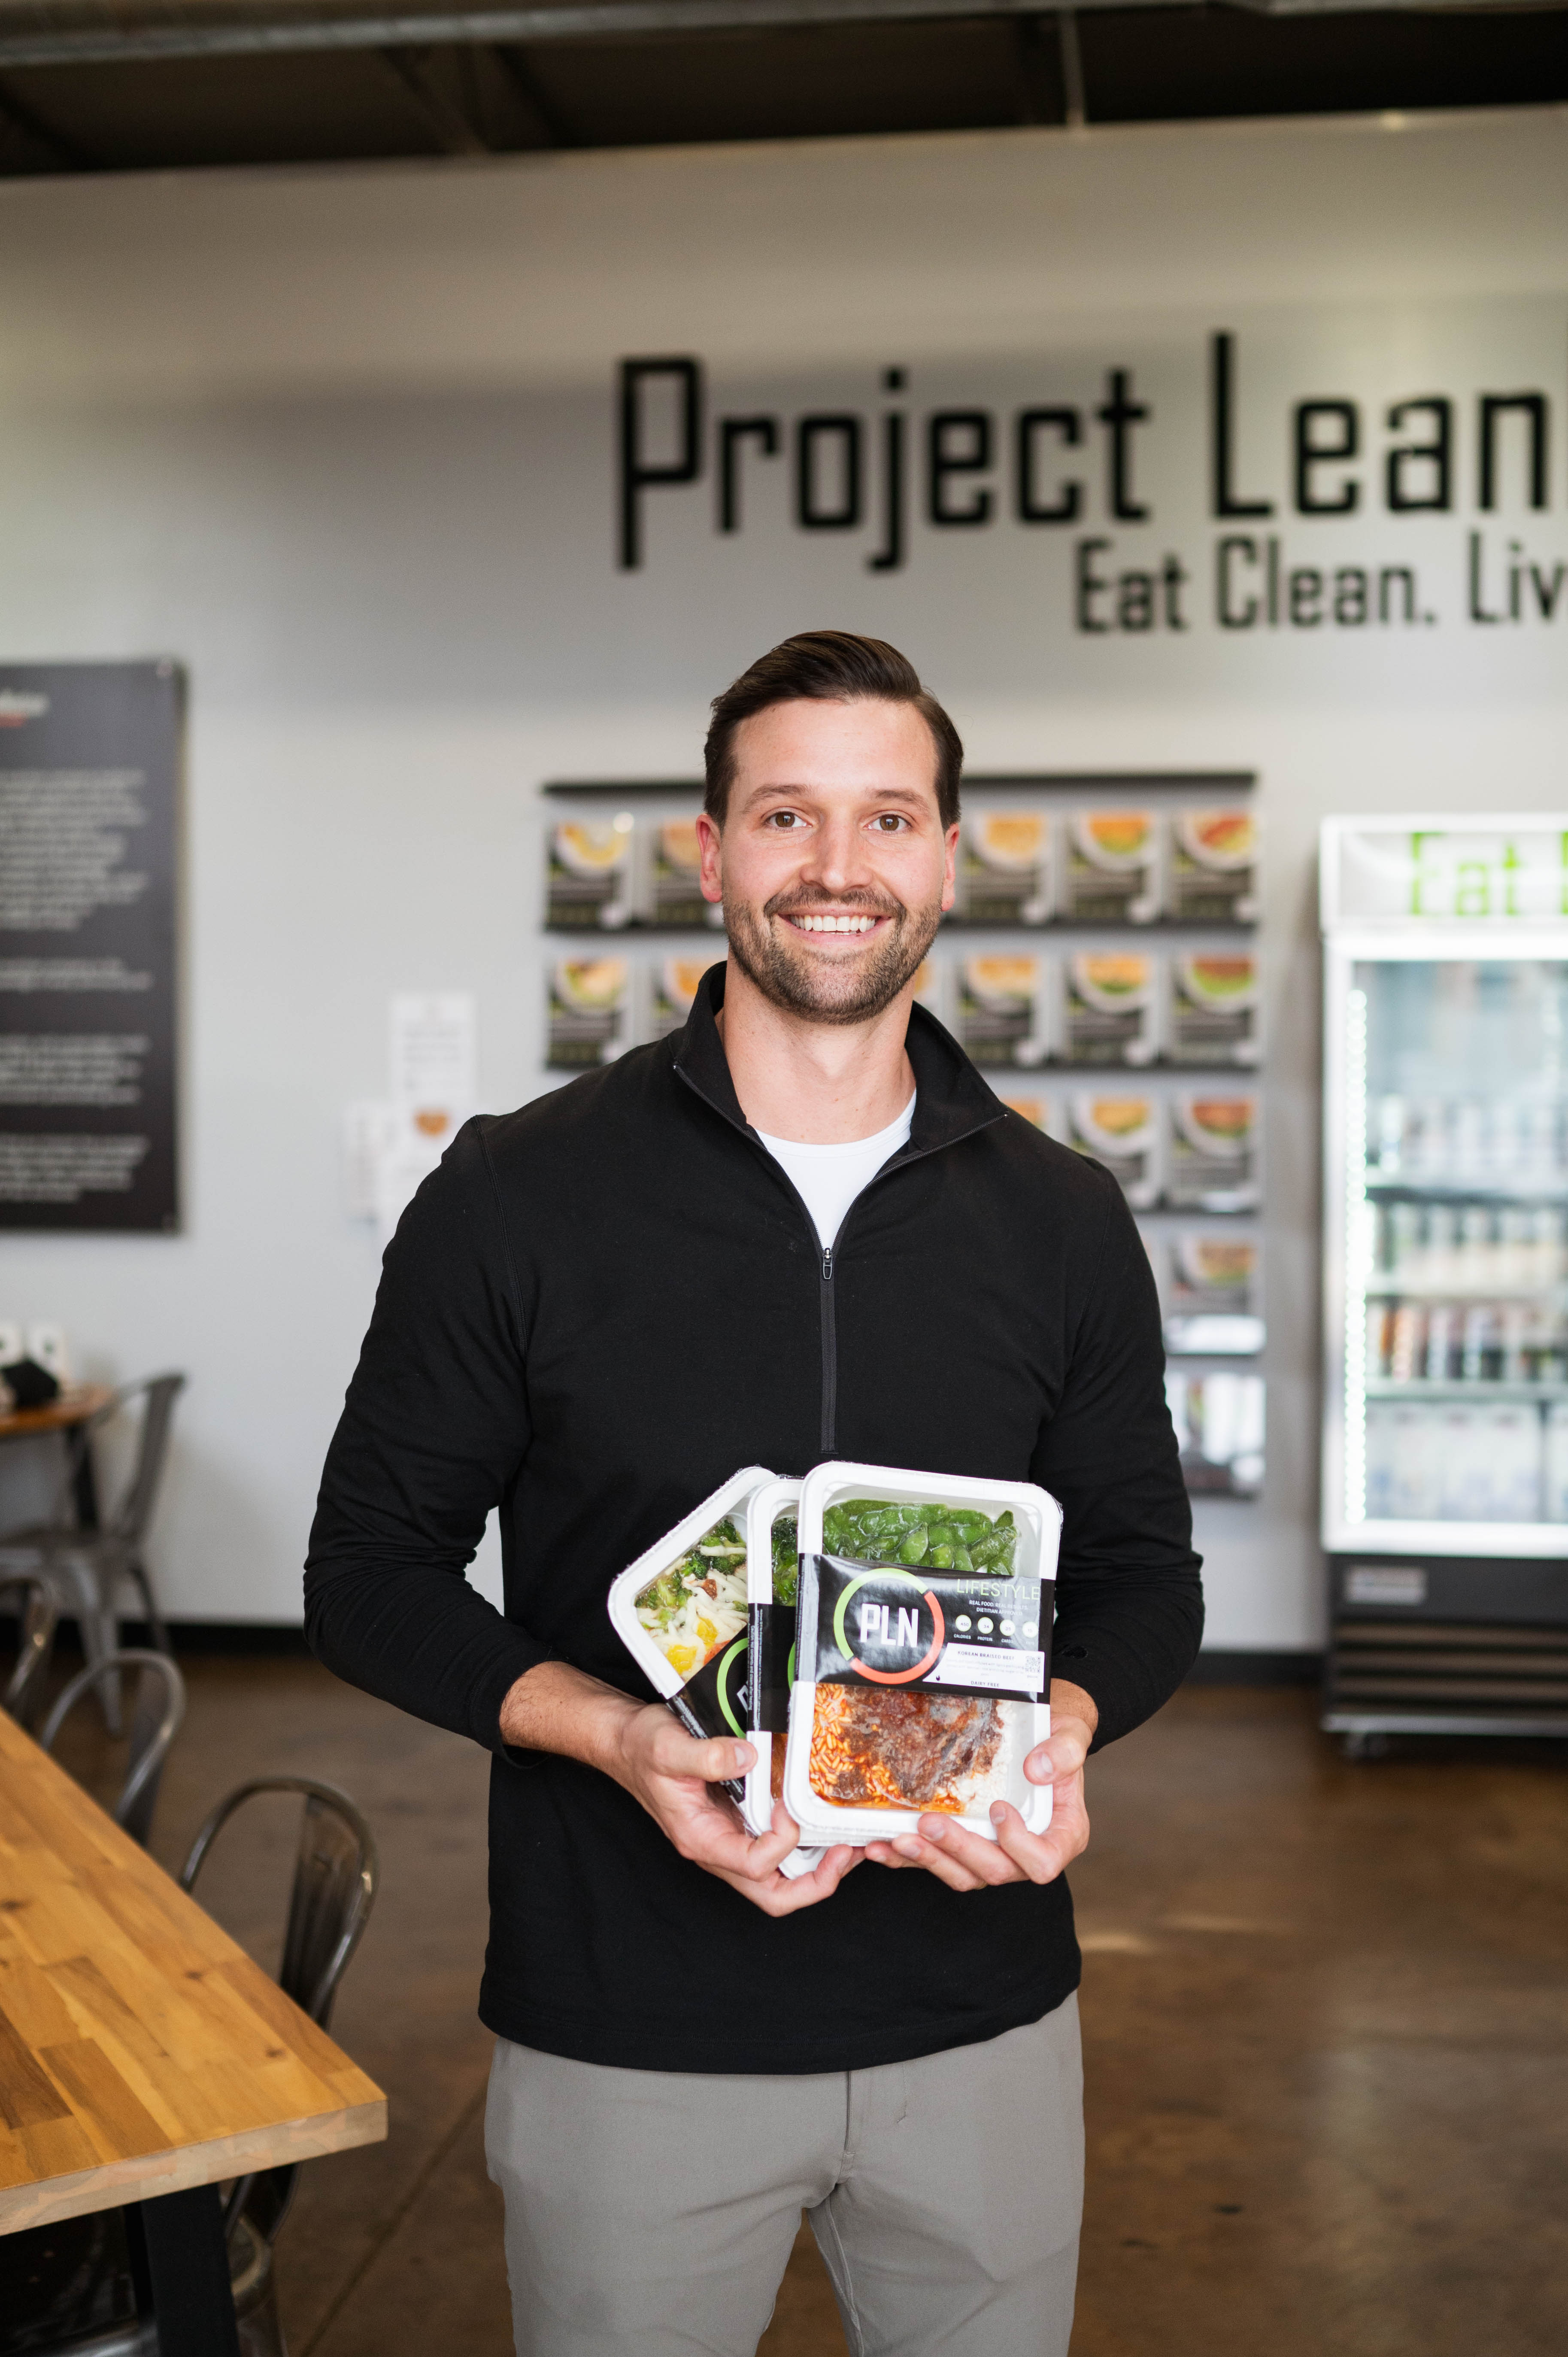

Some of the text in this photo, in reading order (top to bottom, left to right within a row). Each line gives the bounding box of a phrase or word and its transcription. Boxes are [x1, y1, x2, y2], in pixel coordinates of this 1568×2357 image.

[618, 331, 1549, 571] Project Lean
[1077, 537, 1189, 633] Eat
[1216, 532, 1436, 631] Clean.
[860, 1603, 919, 1648] PLN
[957, 1579, 1040, 1600] LIFESTYLE
